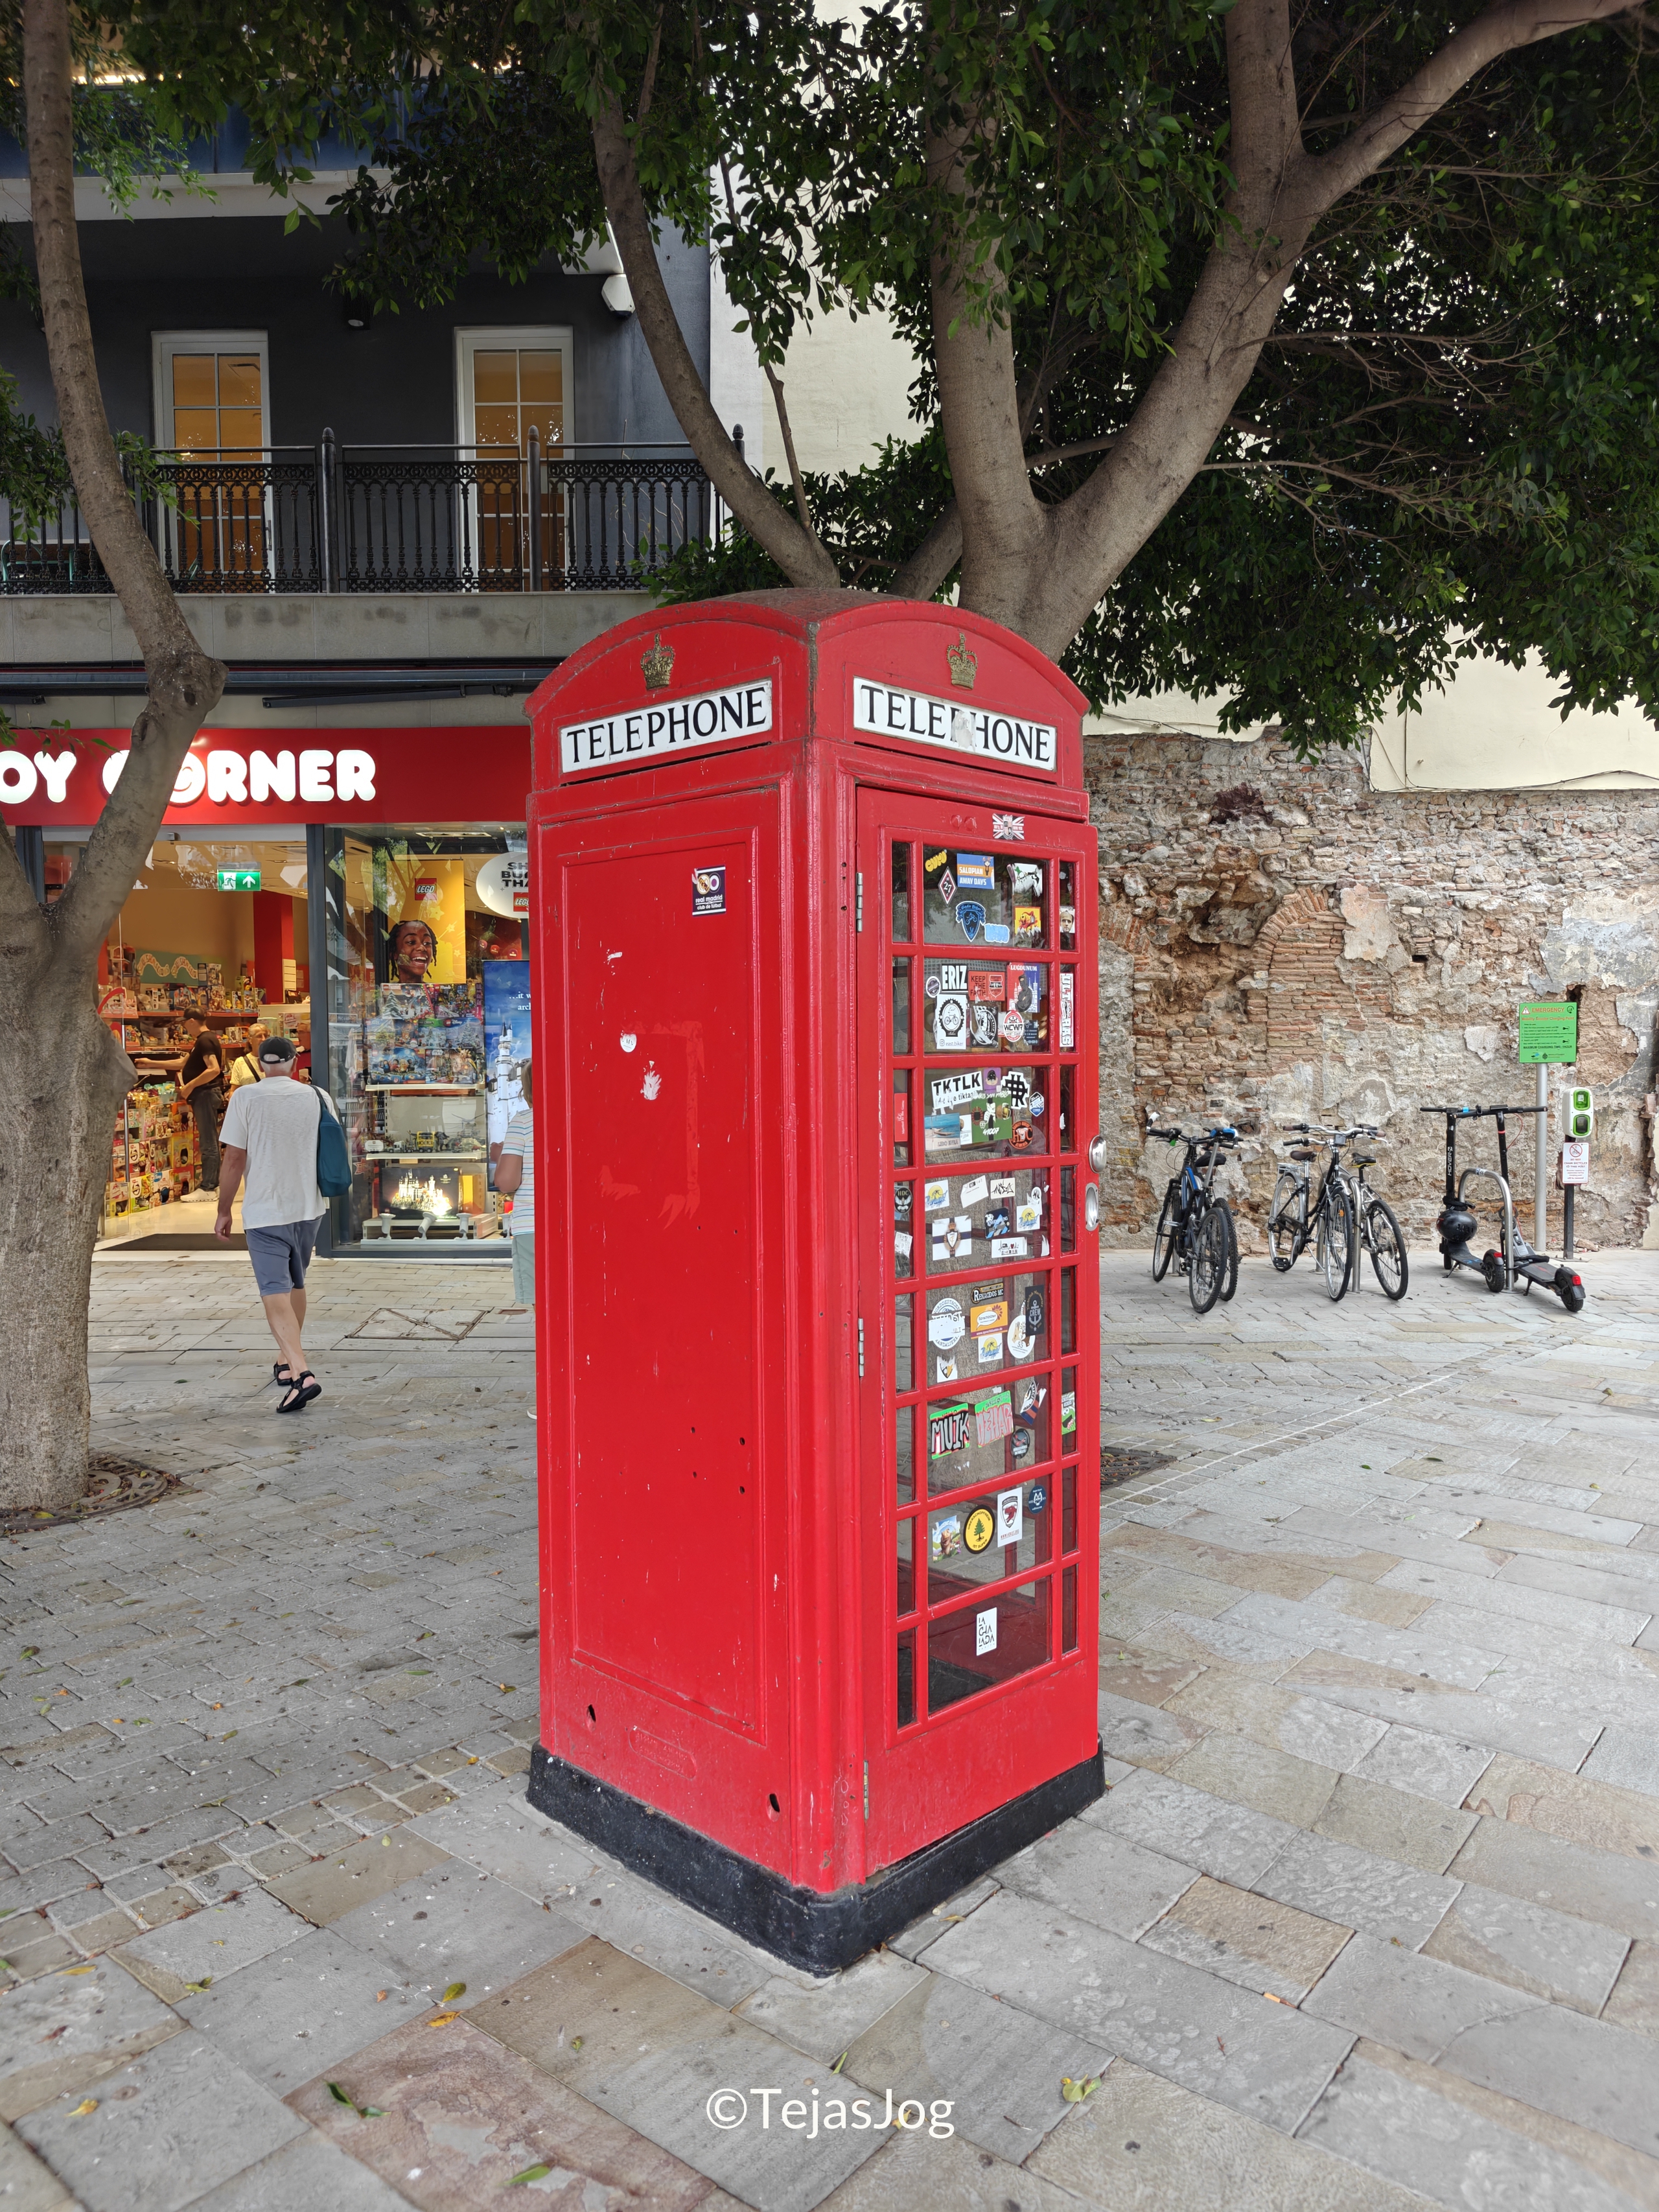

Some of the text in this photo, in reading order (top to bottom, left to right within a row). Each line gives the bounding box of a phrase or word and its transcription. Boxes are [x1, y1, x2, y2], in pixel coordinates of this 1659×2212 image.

[567, 687, 767, 763] TELEPHONE
[861, 685, 1050, 762] TELEHONE
[959, 867, 983, 875] SALOPIAN
[944, 882, 952, 894] 27
[942, 965, 968, 990] ERIZ
[933, 1073, 980, 1096] TKTLK
[982, 1127, 999, 1135] 41007
[1029, 1308, 1041, 1317] CREW
